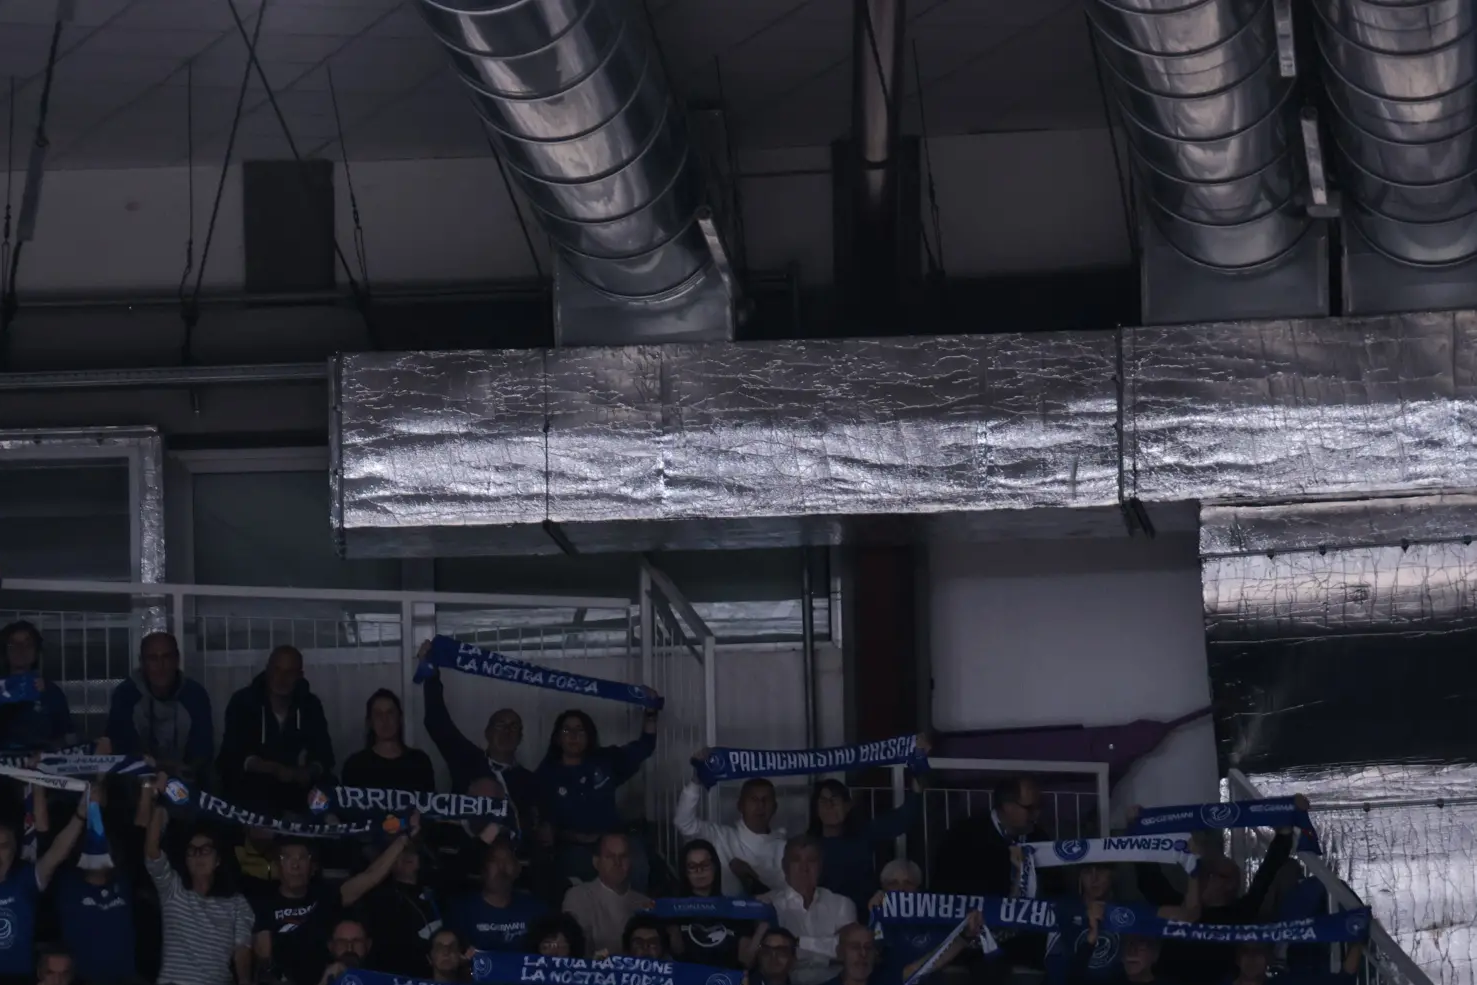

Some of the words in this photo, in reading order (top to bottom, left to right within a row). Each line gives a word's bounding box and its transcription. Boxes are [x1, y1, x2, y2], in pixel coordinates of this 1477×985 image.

[455, 655, 478, 672] LA
[482, 661, 544, 685] NOSTRA
[335, 784, 509, 817] IRRIDUCIBILI
[1102, 836, 1174, 851] GERMANI
[882, 891, 985, 919] GERMAN
[1000, 897, 1057, 928] ORZA
[520, 966, 546, 982] LA
